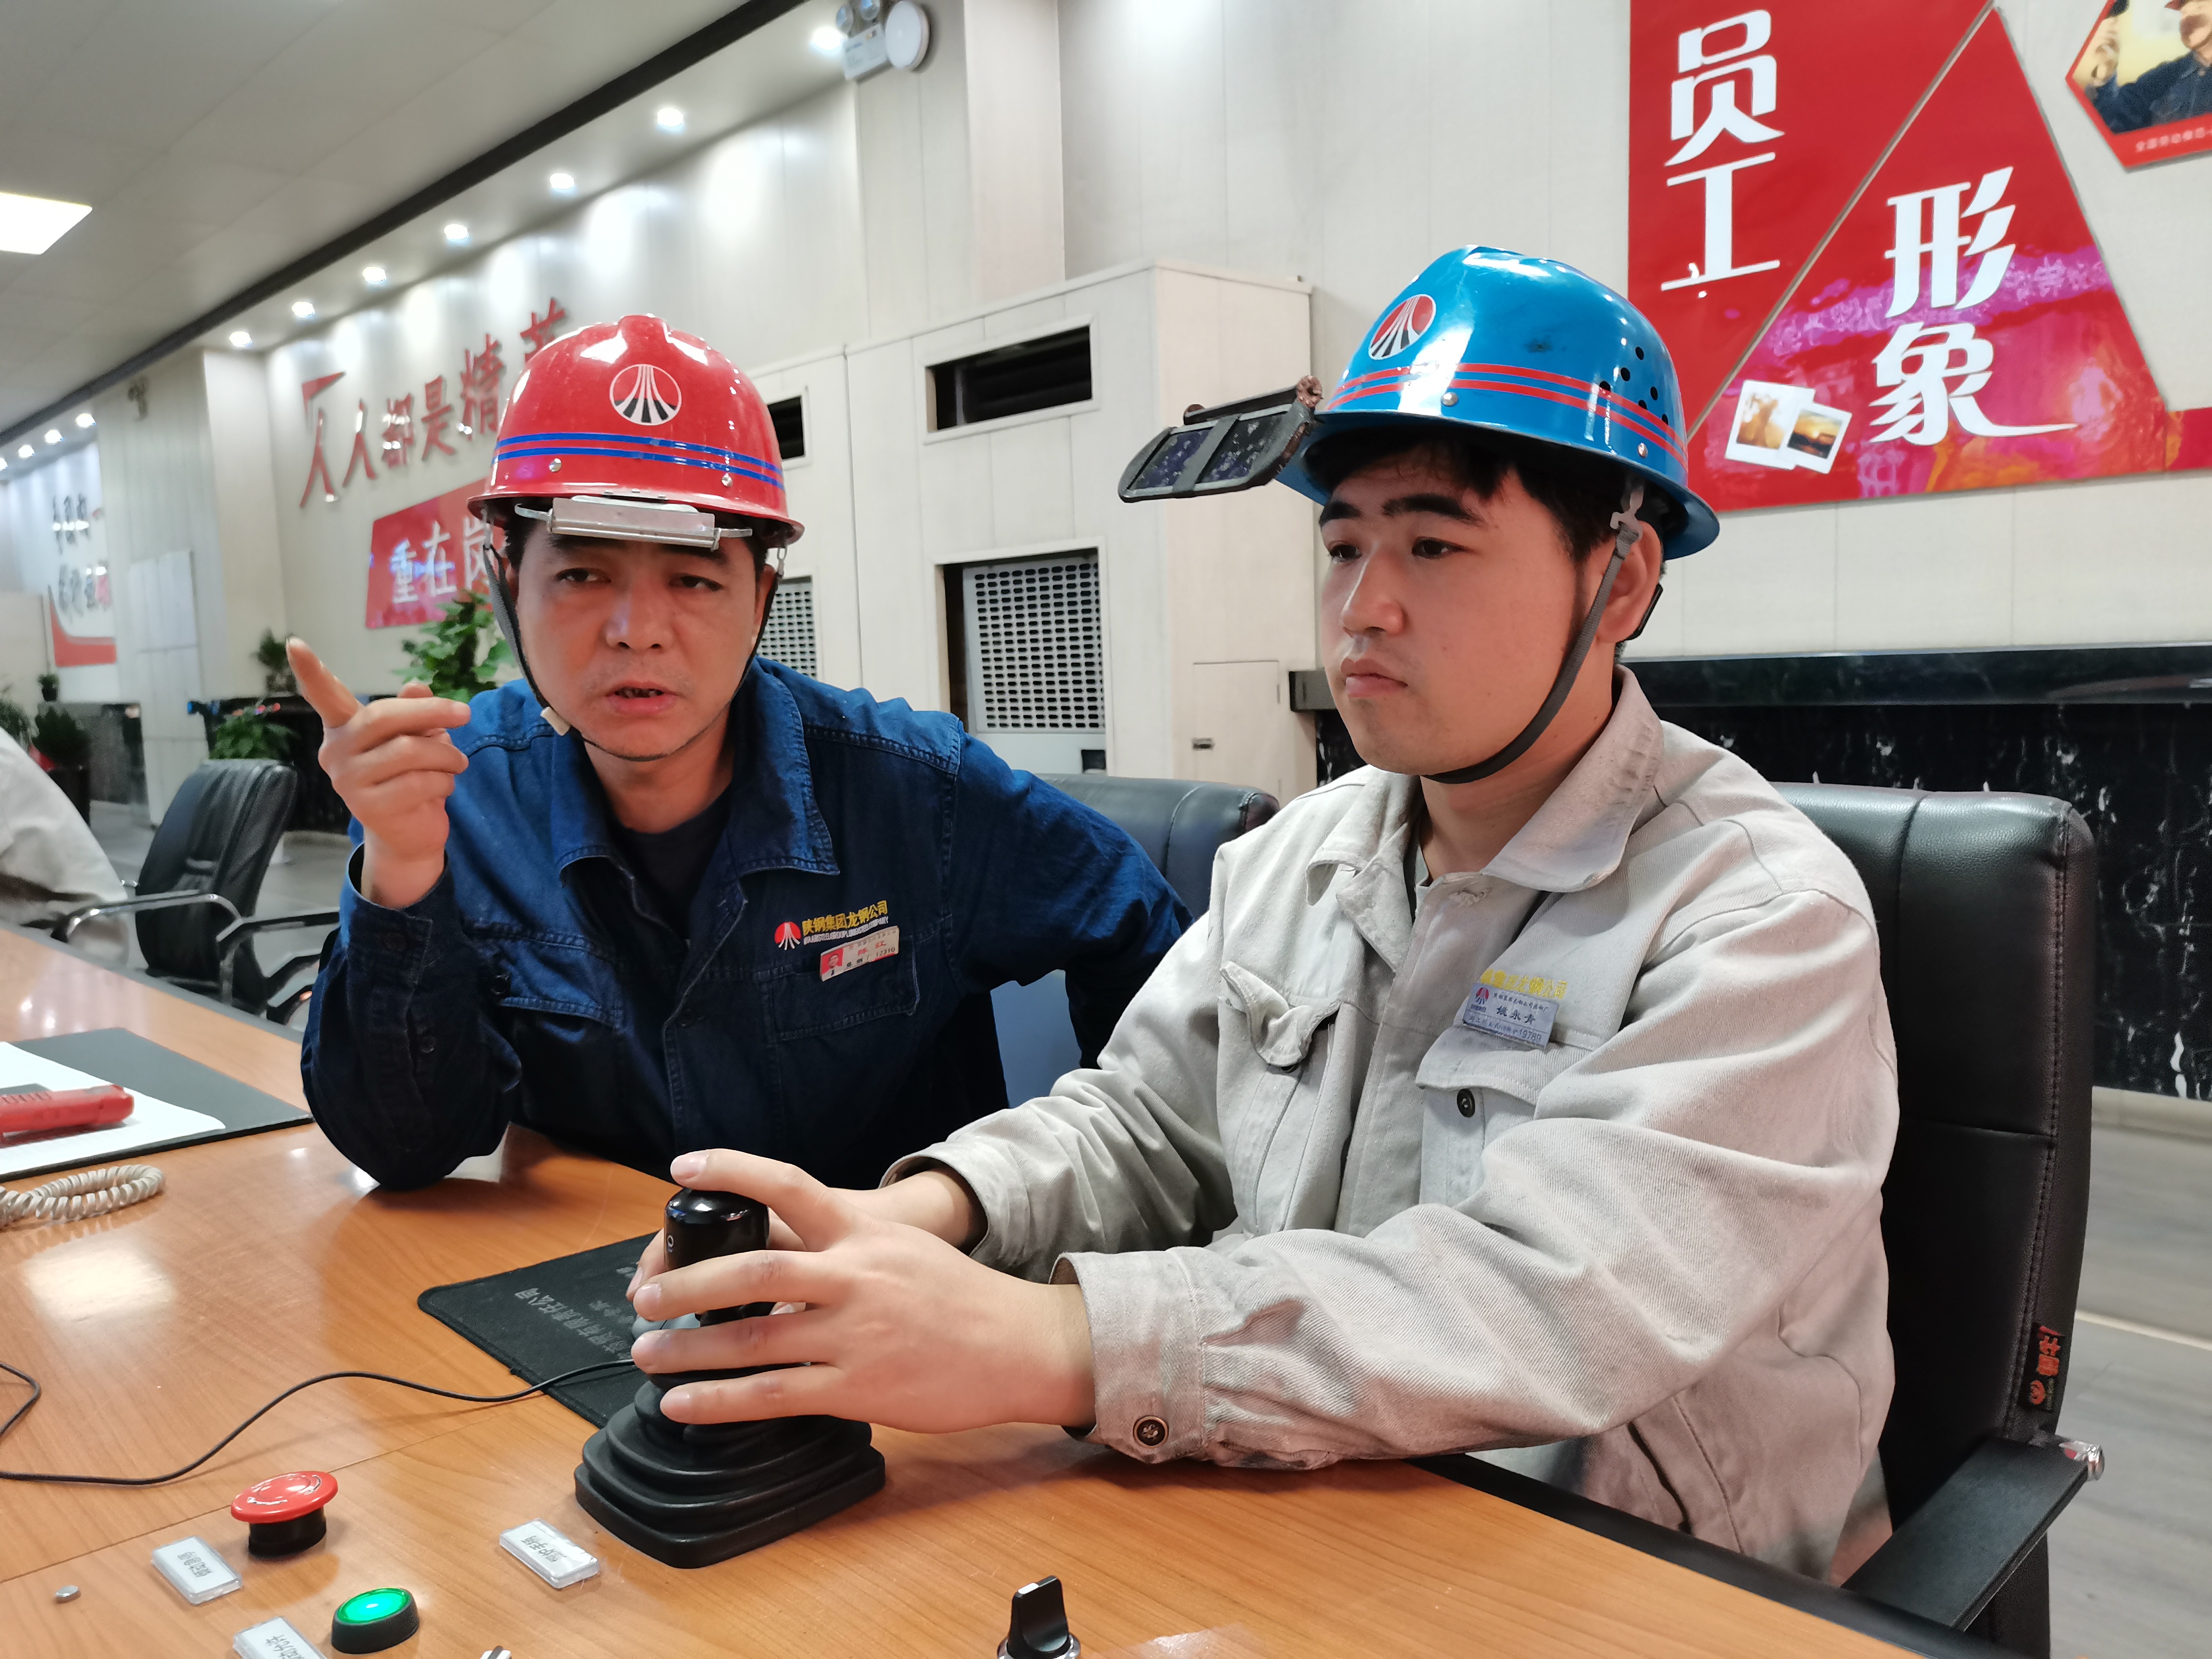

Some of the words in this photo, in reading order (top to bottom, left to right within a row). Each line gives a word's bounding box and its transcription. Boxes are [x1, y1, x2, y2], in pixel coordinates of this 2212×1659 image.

[1661, 9, 1785, 291] 员工
[1869, 166, 2078, 445] 形象
[802, 900, 888, 936] 陕钢集团龙钢公司
